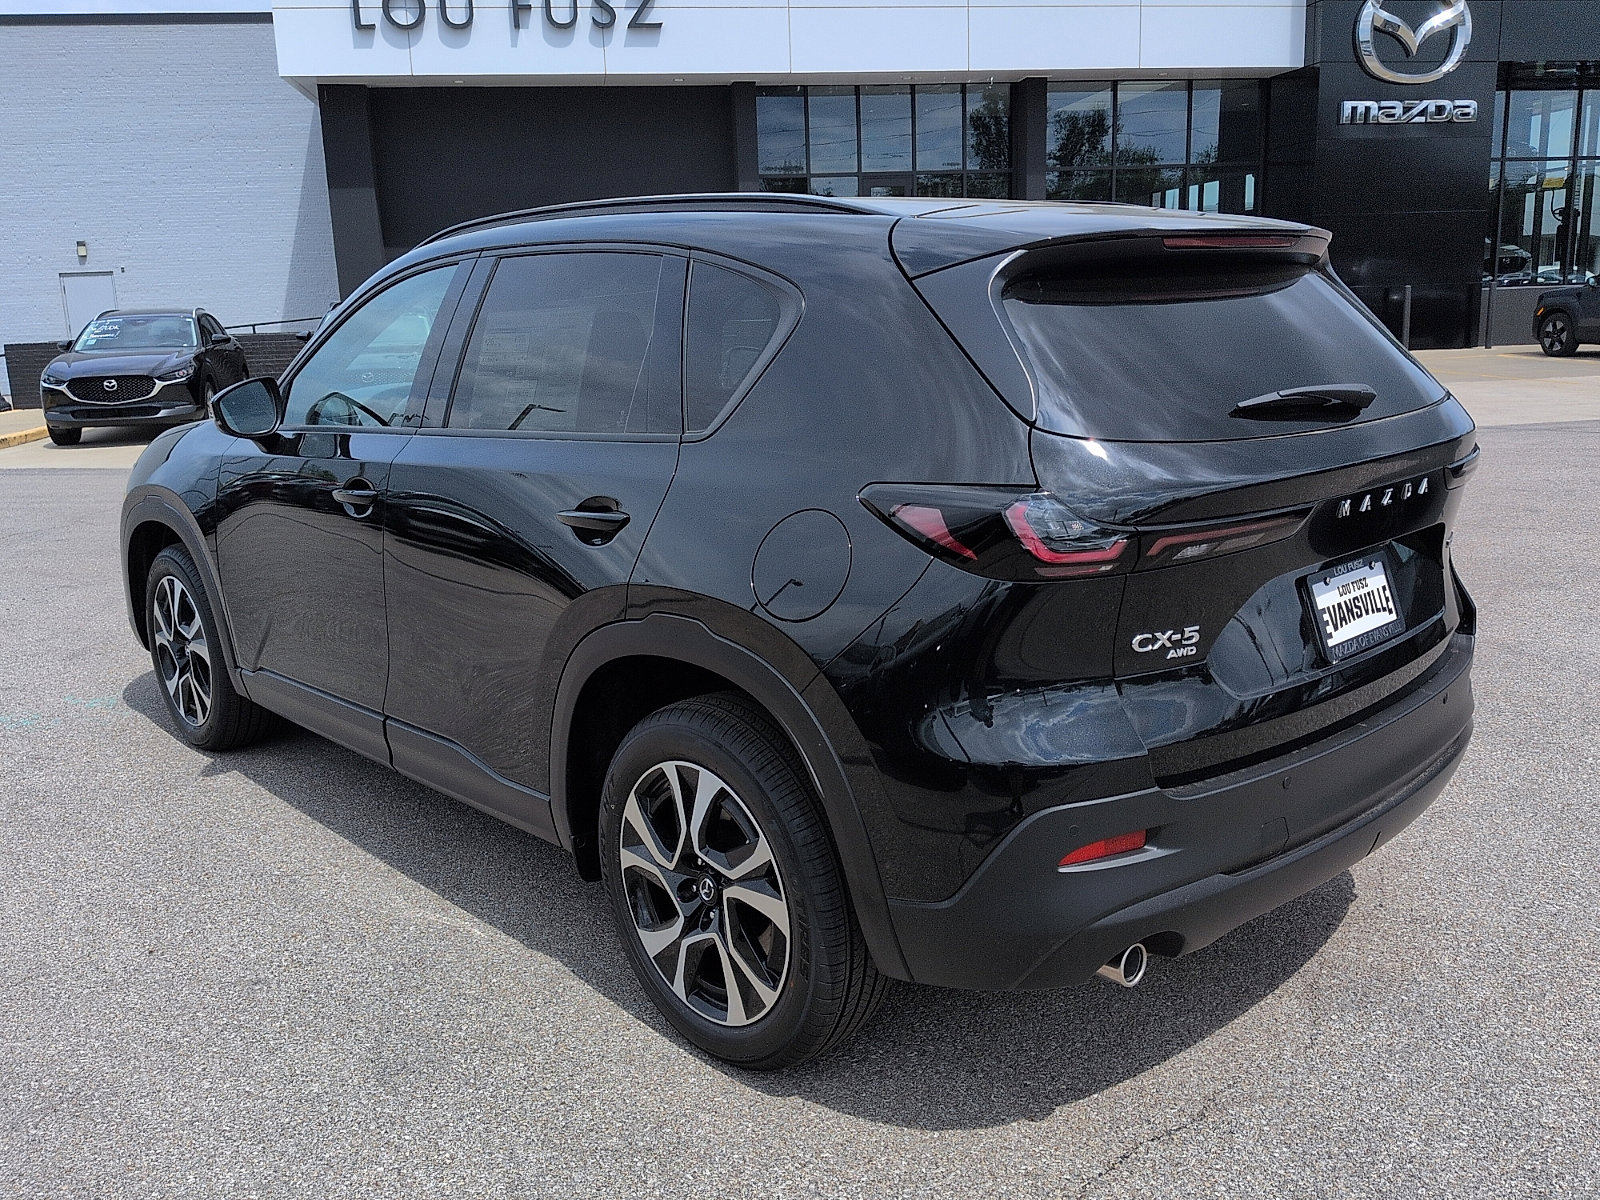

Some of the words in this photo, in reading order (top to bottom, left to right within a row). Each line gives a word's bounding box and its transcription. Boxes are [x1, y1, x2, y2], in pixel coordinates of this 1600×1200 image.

[352, 0, 474, 29] LOU
[511, 0, 664, 29] FUSZ
[1336, 477, 1428, 518] MAZDA
[1333, 564, 1348, 576] LOU
[1347, 559, 1365, 572] FUSZ
[1337, 582, 1352, 597] LOU
[1352, 577, 1369, 592] FUSZ
[1318, 585, 1394, 639] EVANSVILLE
[1131, 625, 1200, 652] CX-5
[1331, 639, 1360, 660] MAZDA
[1359, 634, 1369, 647] OF
[1166, 645, 1197, 660] AWD
